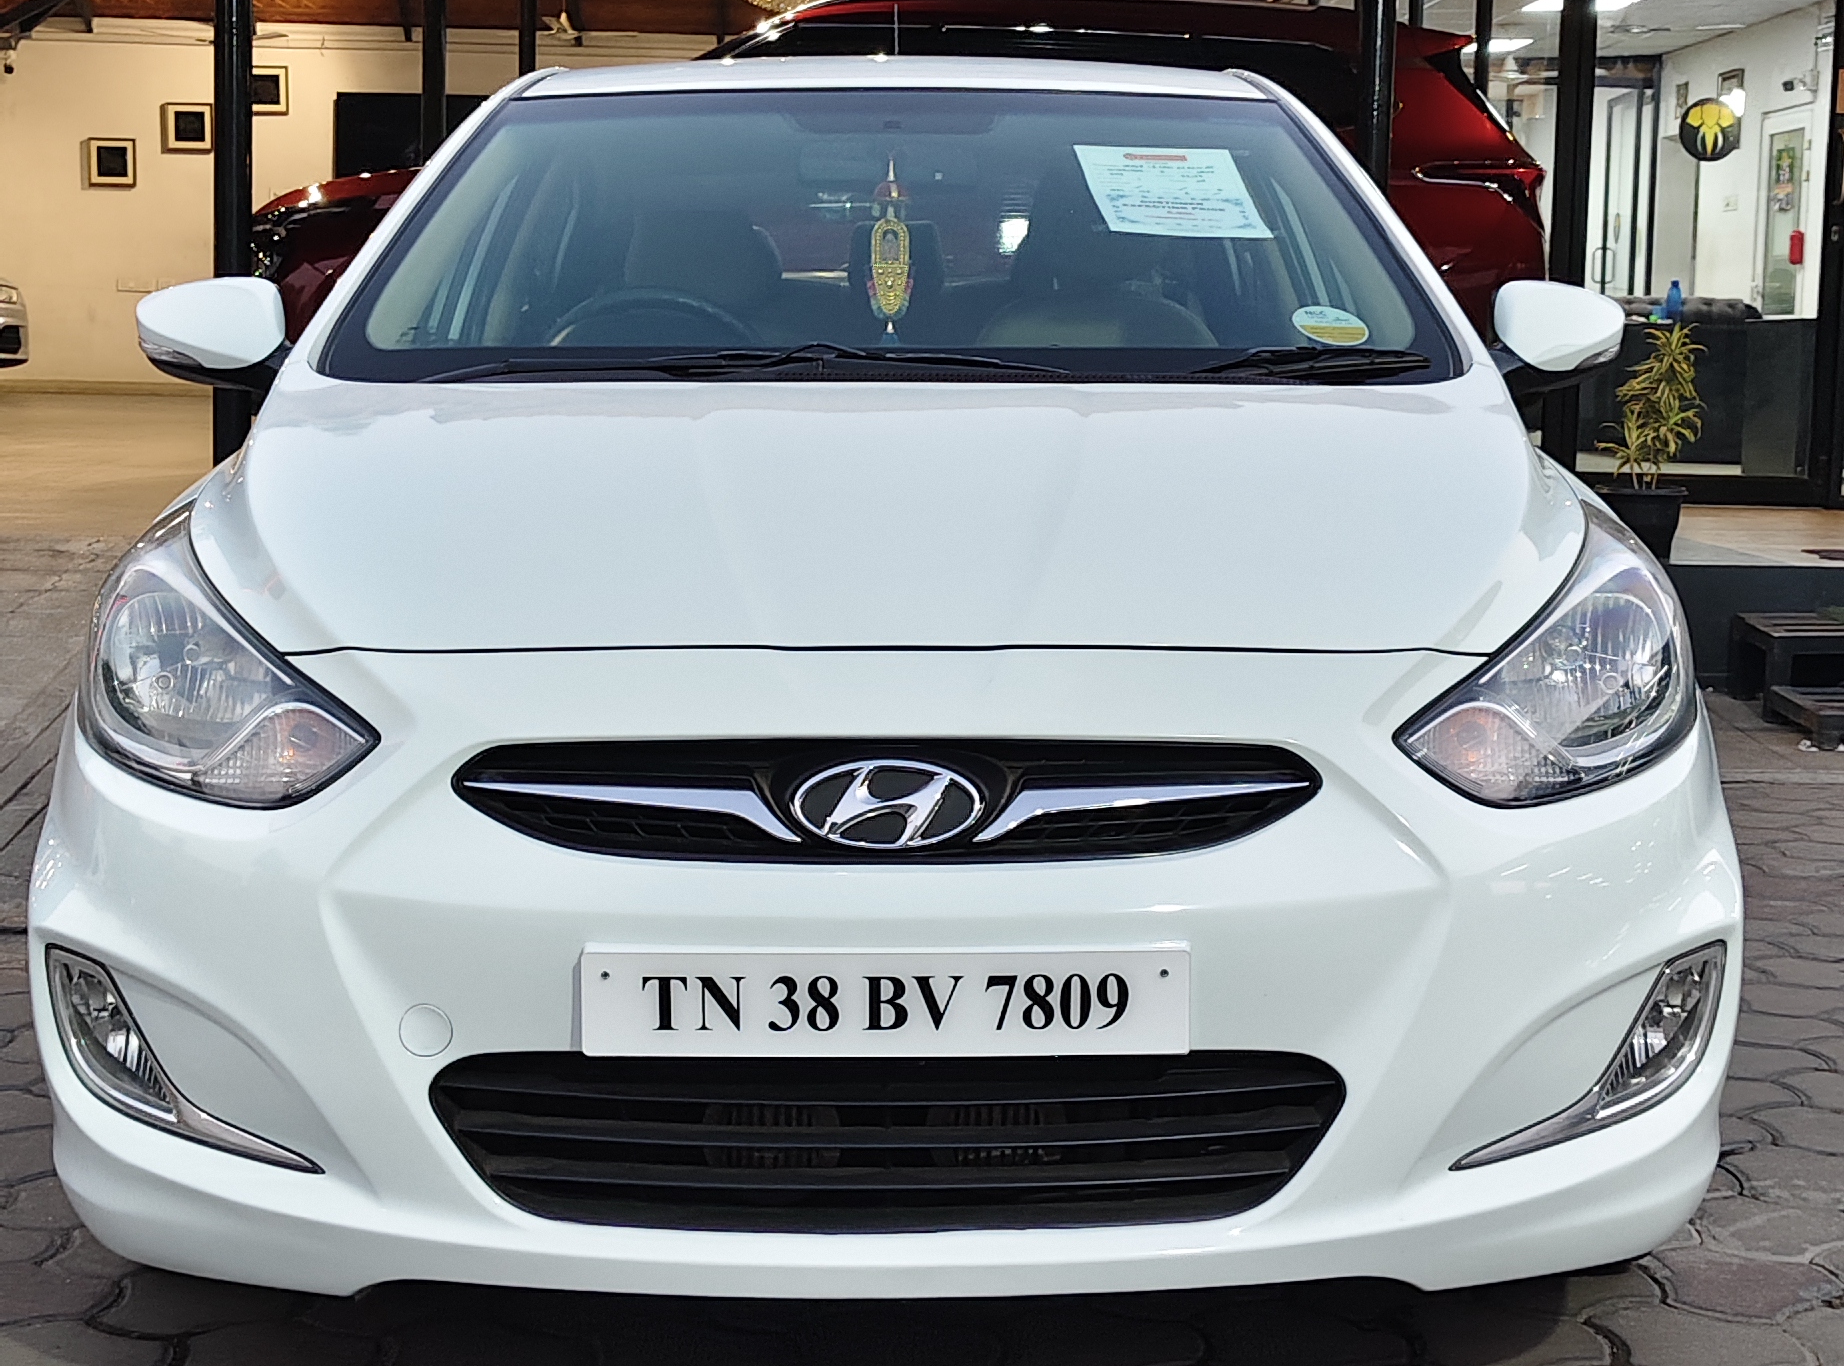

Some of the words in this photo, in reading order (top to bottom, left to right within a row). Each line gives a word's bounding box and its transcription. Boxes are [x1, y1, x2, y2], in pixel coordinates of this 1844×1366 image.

[642, 976, 747, 1031] TN
[769, 975, 839, 1031] 38
[863, 976, 964, 1031] BV
[985, 973, 1129, 1031] 7809
